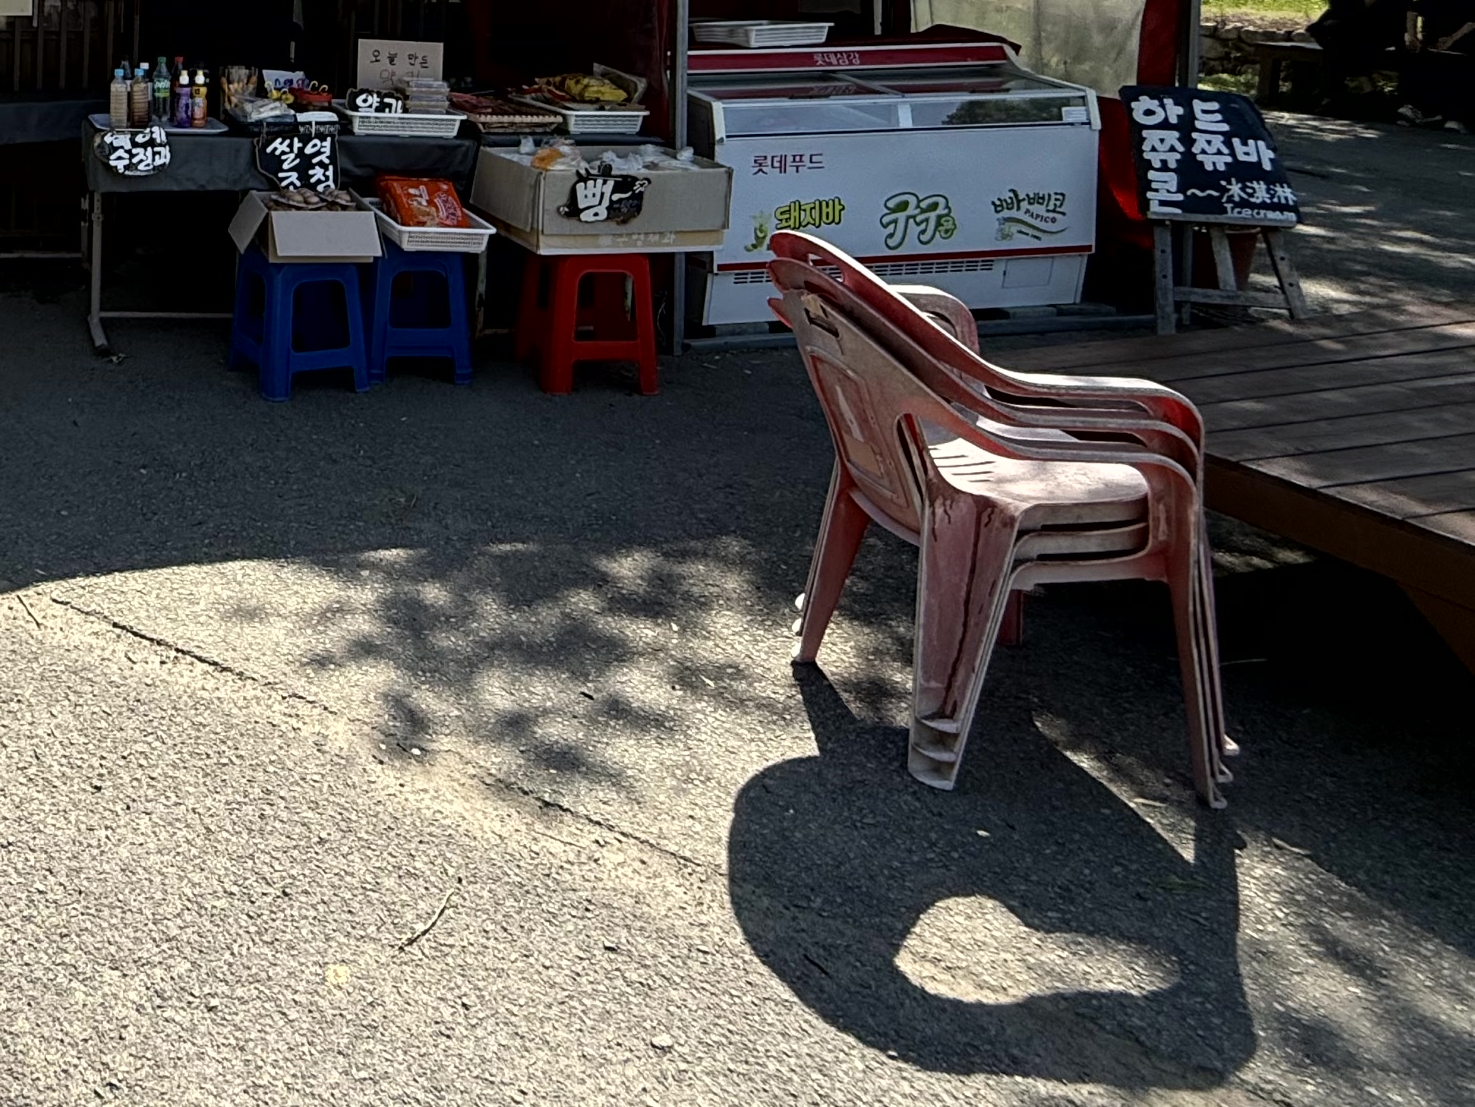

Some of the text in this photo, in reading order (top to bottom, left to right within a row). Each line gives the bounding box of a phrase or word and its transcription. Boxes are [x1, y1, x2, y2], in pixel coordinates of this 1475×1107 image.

[369, 49, 430, 69] 오늘 만든
[812, 51, 861, 66] 롯데삼강
[1130, 95, 1231, 132] 하드
[108, 145, 172, 174] 수정과
[265, 136, 332, 170] 쌀엿
[751, 152, 826, 176] 롯데푸드
[1141, 129, 1275, 172] 쮸쮸바
[277, 164, 336, 193] 조청
[1146, 169, 1298, 215] 콘 冰淇淋
[575, 178, 615, 223] 뻥
[774, 195, 846, 231] 돼지바
[990, 188, 1067, 217] 빠삐코
[1023, 208, 1058, 224] PAPICO
